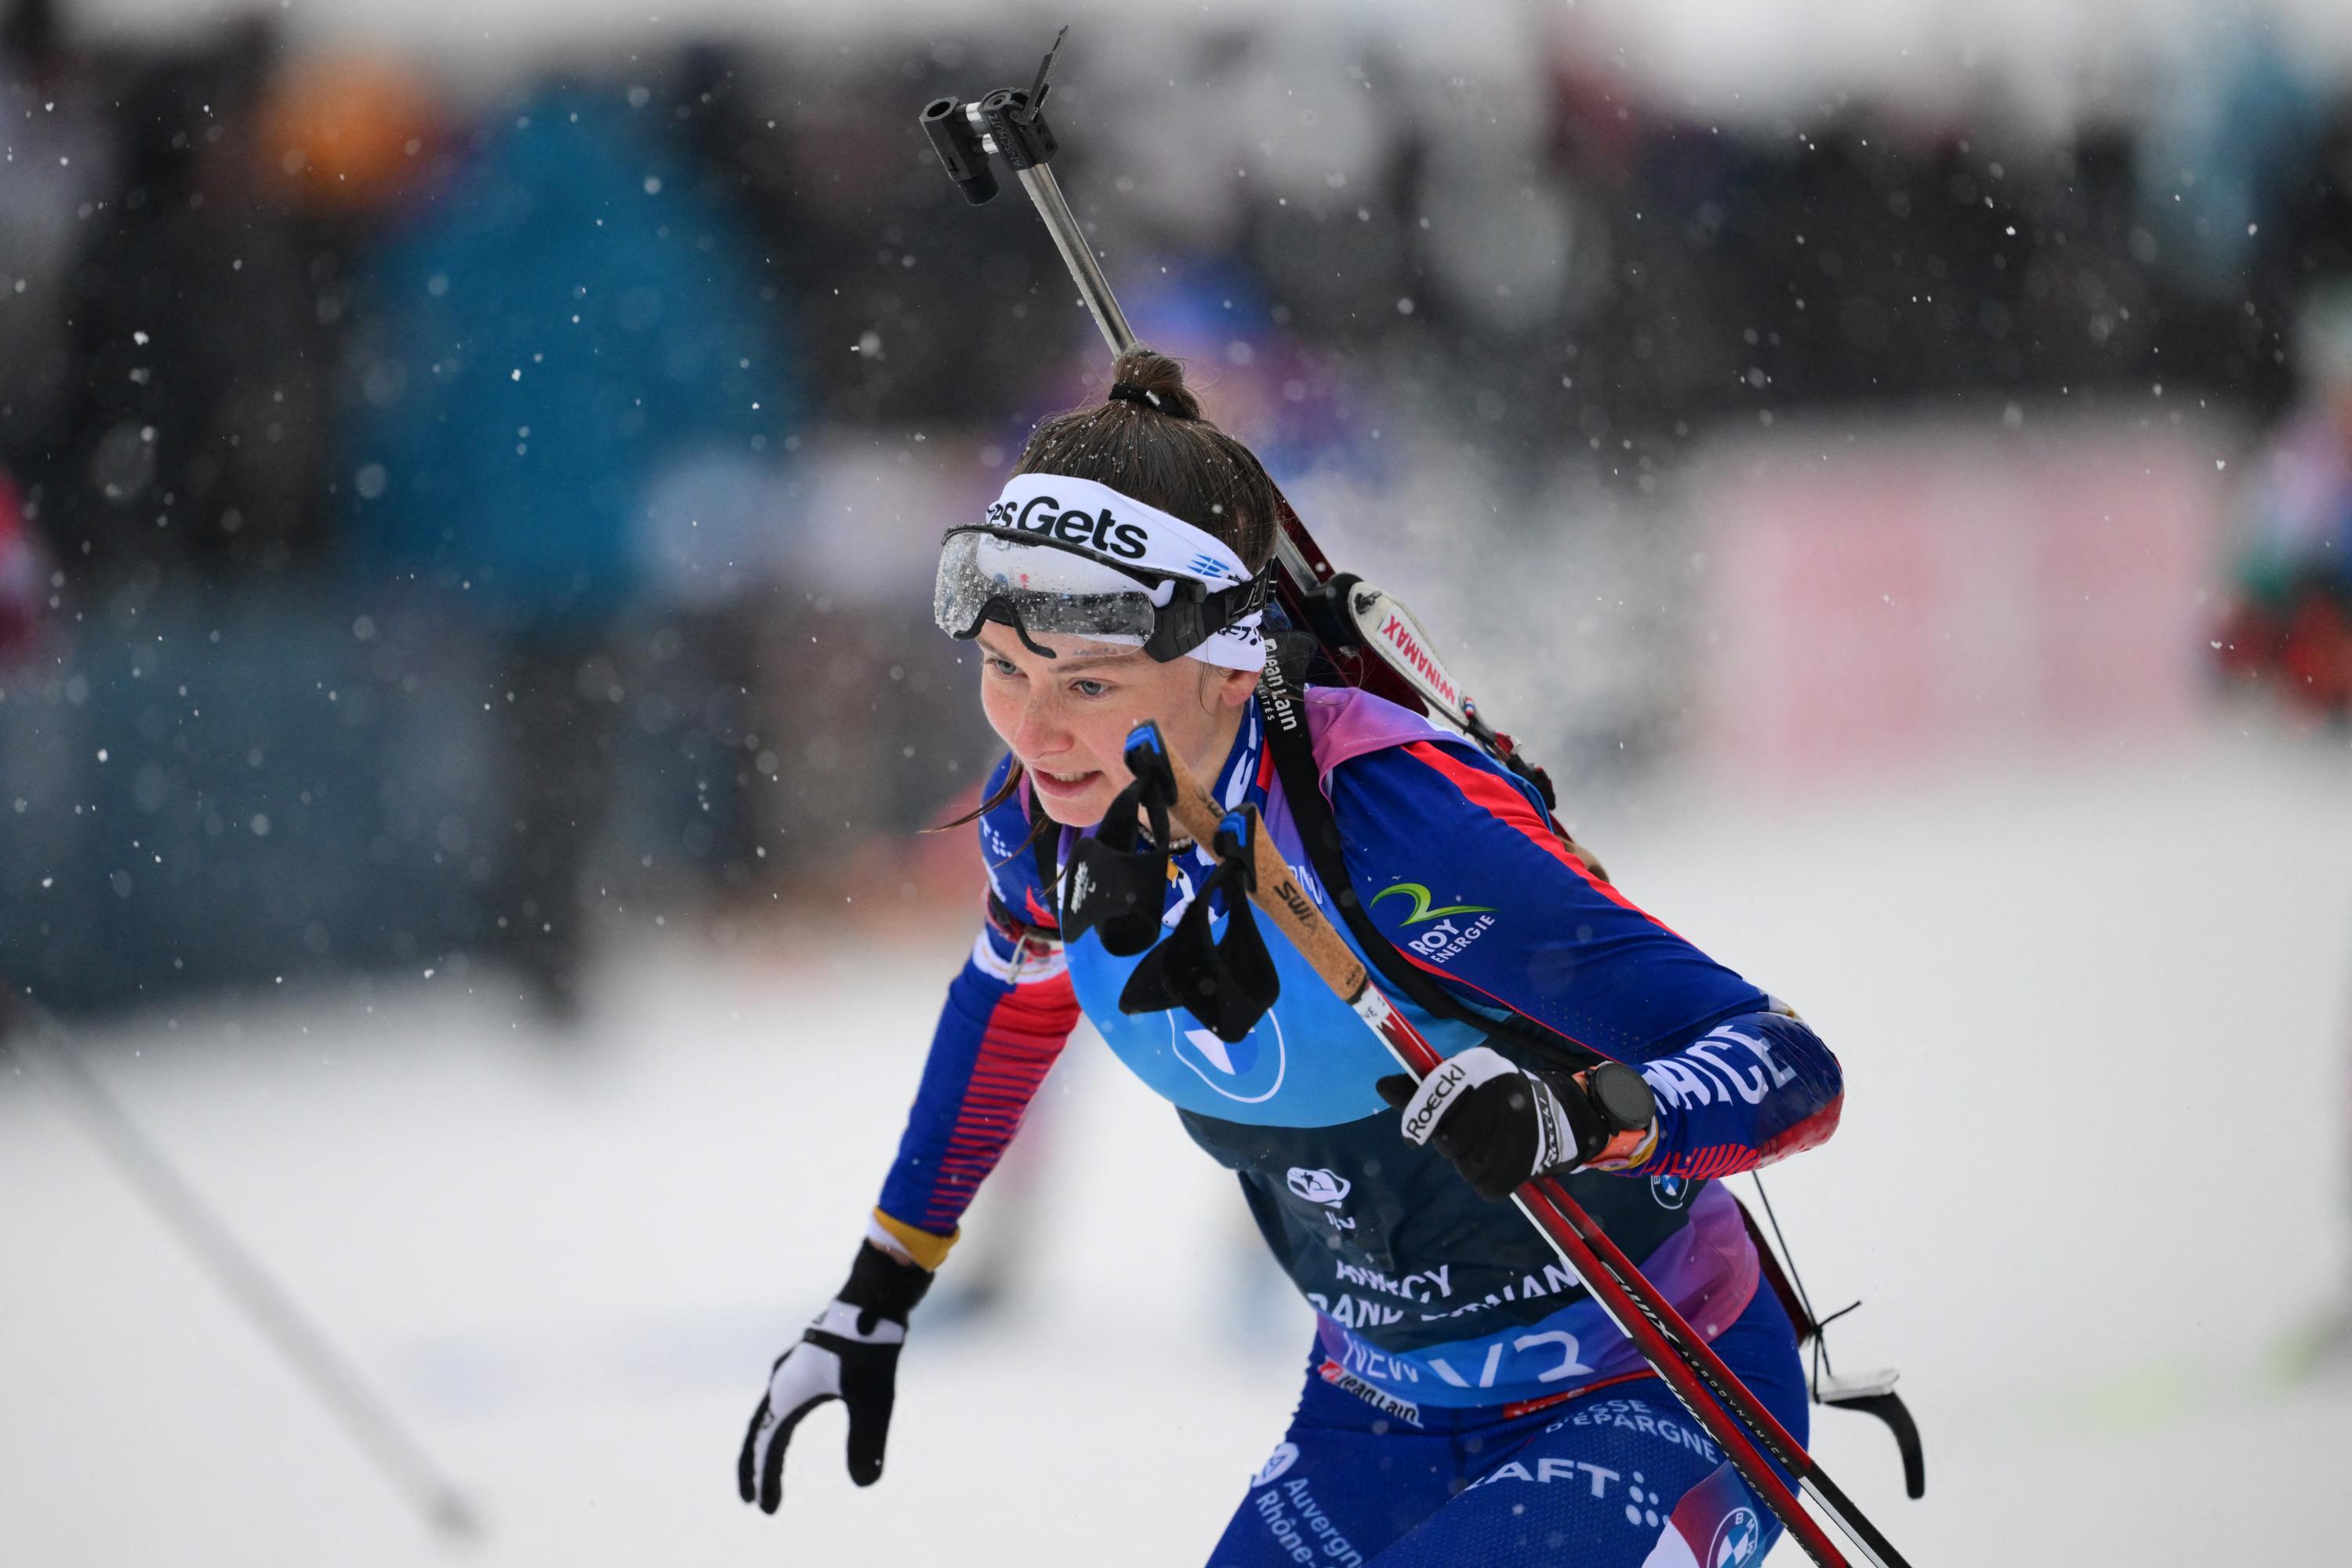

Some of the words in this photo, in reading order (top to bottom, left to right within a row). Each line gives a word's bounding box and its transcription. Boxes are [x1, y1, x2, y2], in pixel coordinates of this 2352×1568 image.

[1017, 495, 1149, 559] Gets
[1382, 615, 1456, 705] WINAMAX
[1272, 688, 1298, 731] Lain
[1408, 919, 1459, 955] ROY
[1430, 915, 1495, 964] ENERGIE
[1682, 1351, 1788, 1465] AERODYNAMICS
[1545, 1412, 1718, 1465] D'ÉPARGNE
[1463, 1458, 1620, 1499] AFT
[1257, 1490, 1318, 1568] Rhône-
[1283, 1478, 1364, 1568] Auvergn
